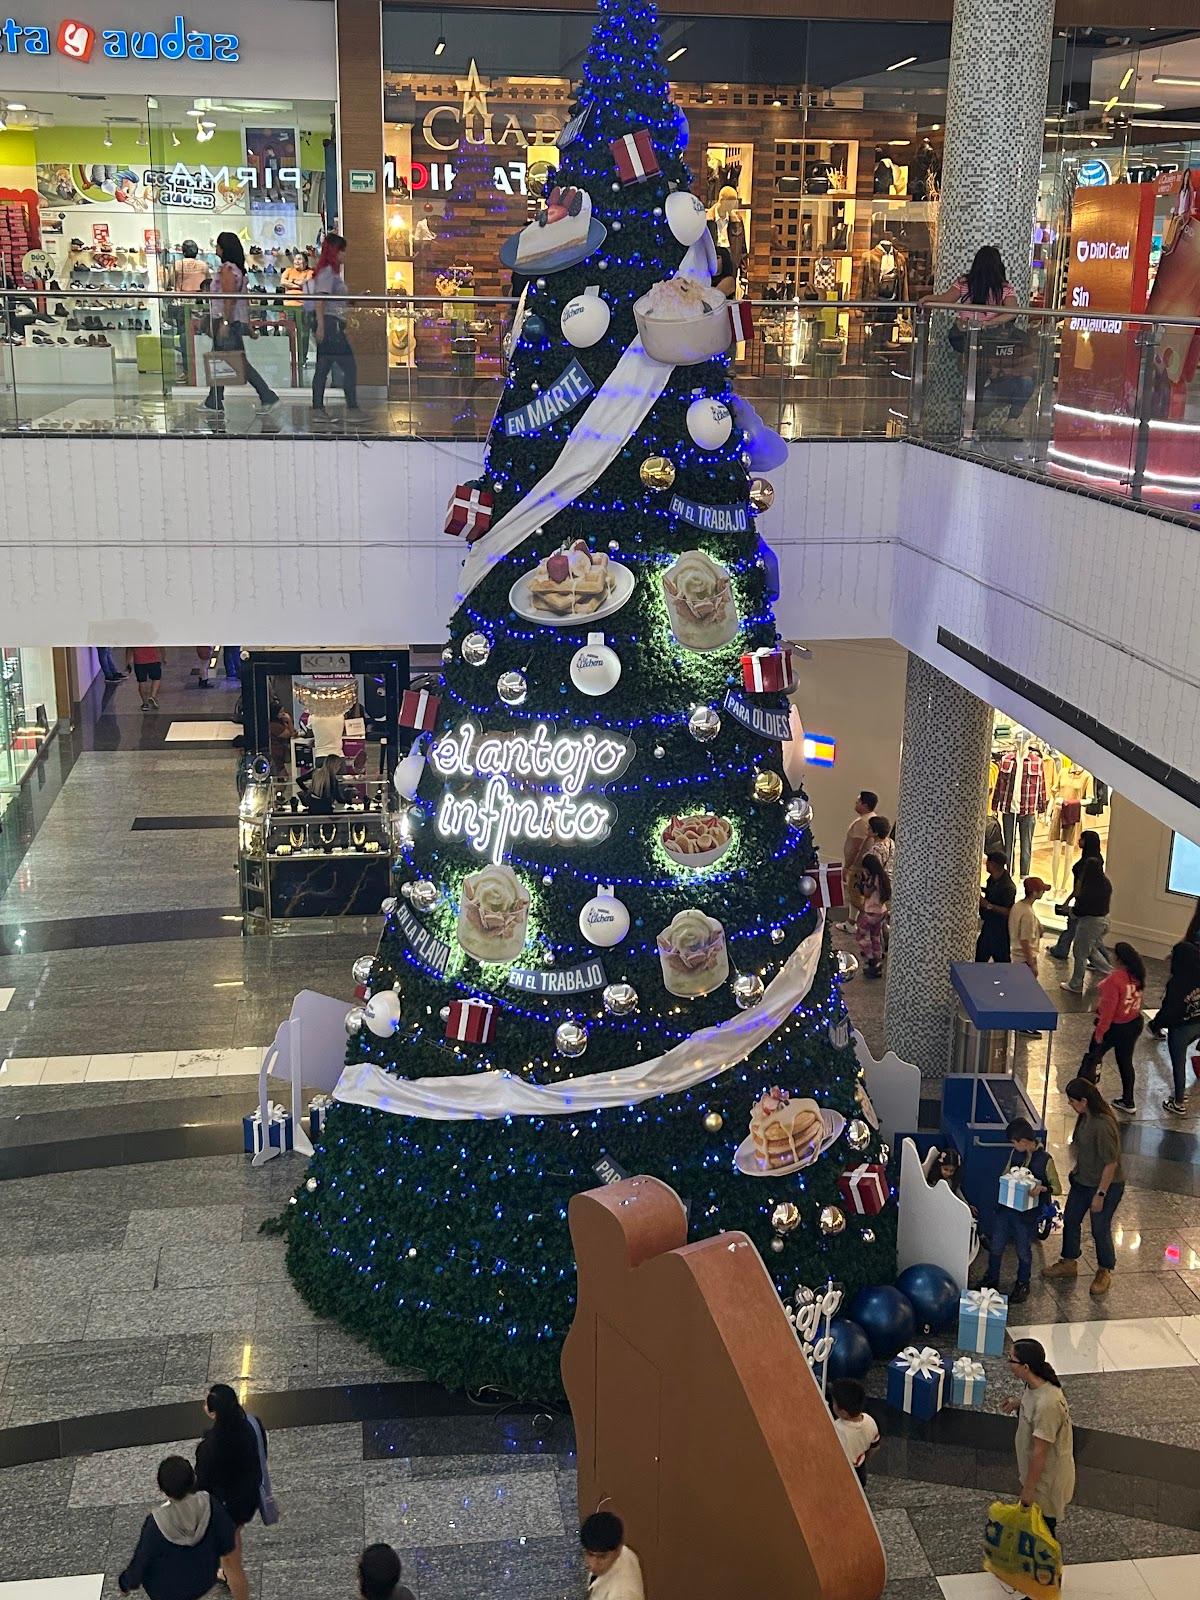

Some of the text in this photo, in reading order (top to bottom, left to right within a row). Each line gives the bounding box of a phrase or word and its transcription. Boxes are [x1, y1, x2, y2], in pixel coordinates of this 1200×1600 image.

[0, 18, 50, 54] ta
[103, 16, 239, 62] audaz
[422, 106, 562, 151] CUAD
[1089, 241, 1130, 260] DiDi Card
[1072, 286, 1090, 307] Sin
[508, 367, 589, 435] EN MARTE
[672, 498, 747, 531] EN EL TRABAJO
[728, 696, 789, 738] PARA OLDIES
[476, 724, 626, 796] antojo
[438, 775, 609, 866] infinito
[397, 904, 449, 972] EN LA PLAYA
[509, 964, 602, 992] EN EL TRABAJO
[595, 1160, 622, 1185] PAR
